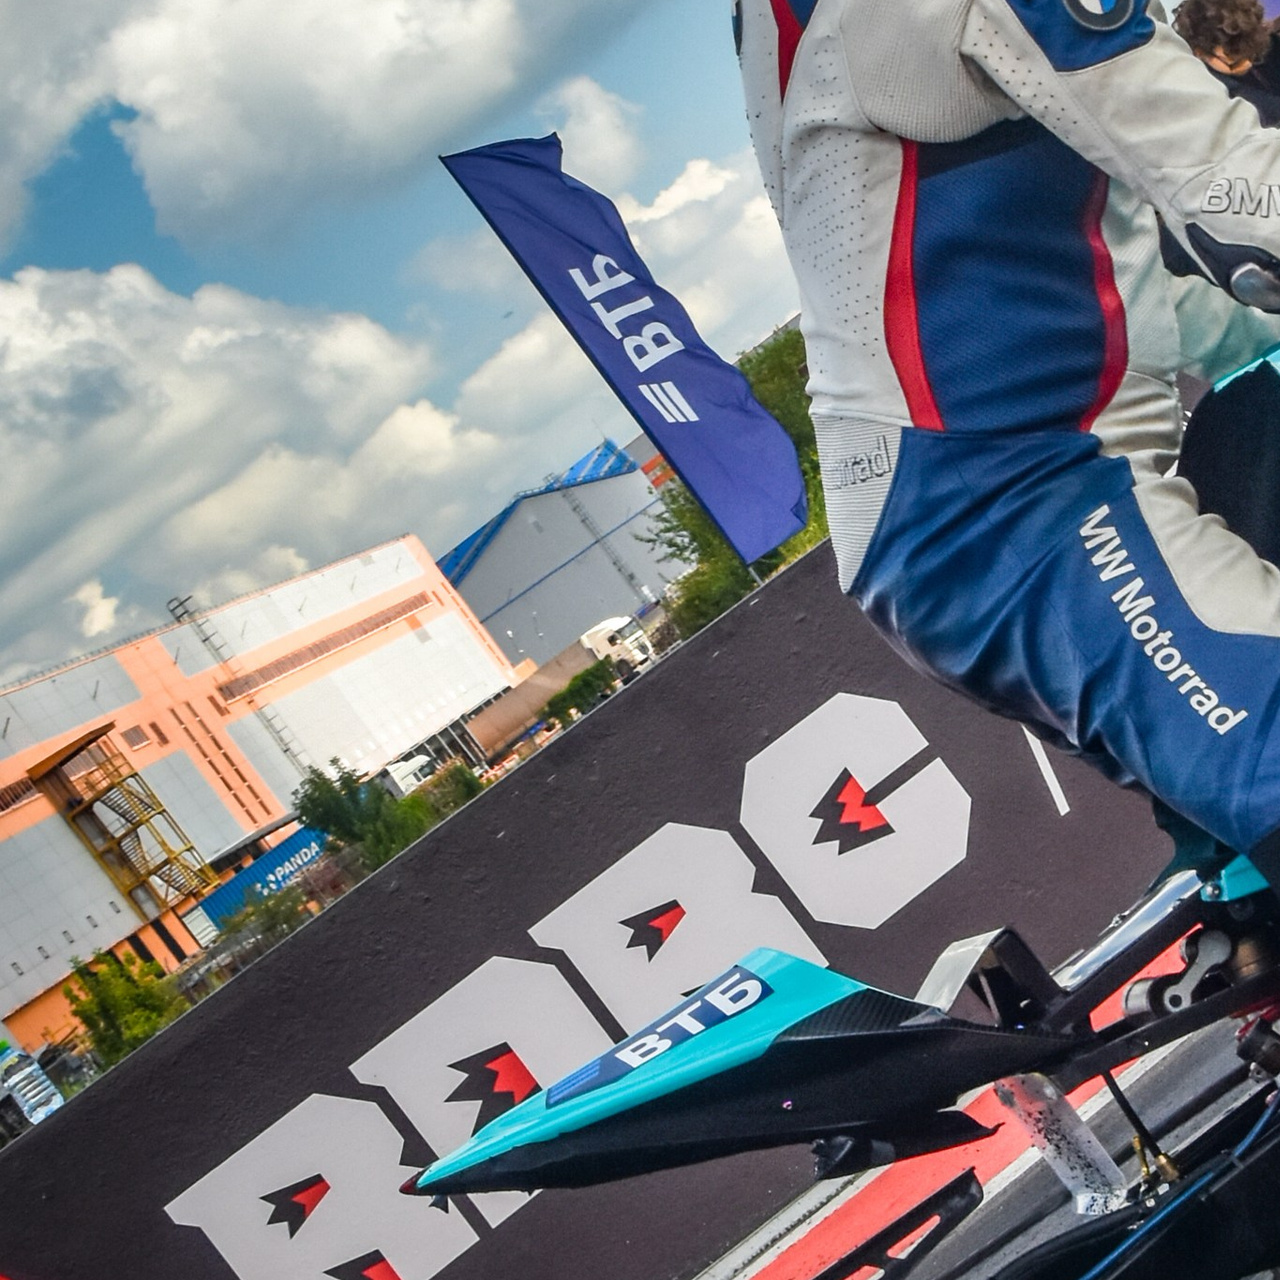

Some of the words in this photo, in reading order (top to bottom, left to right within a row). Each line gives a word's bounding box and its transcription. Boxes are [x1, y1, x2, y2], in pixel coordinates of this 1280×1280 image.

[568, 254, 686, 373] ВТБ
[1111, 576, 1249, 736] Motorrad
[274, 841, 321, 881] PANDA
[614, 972, 762, 1068] ВТБ
